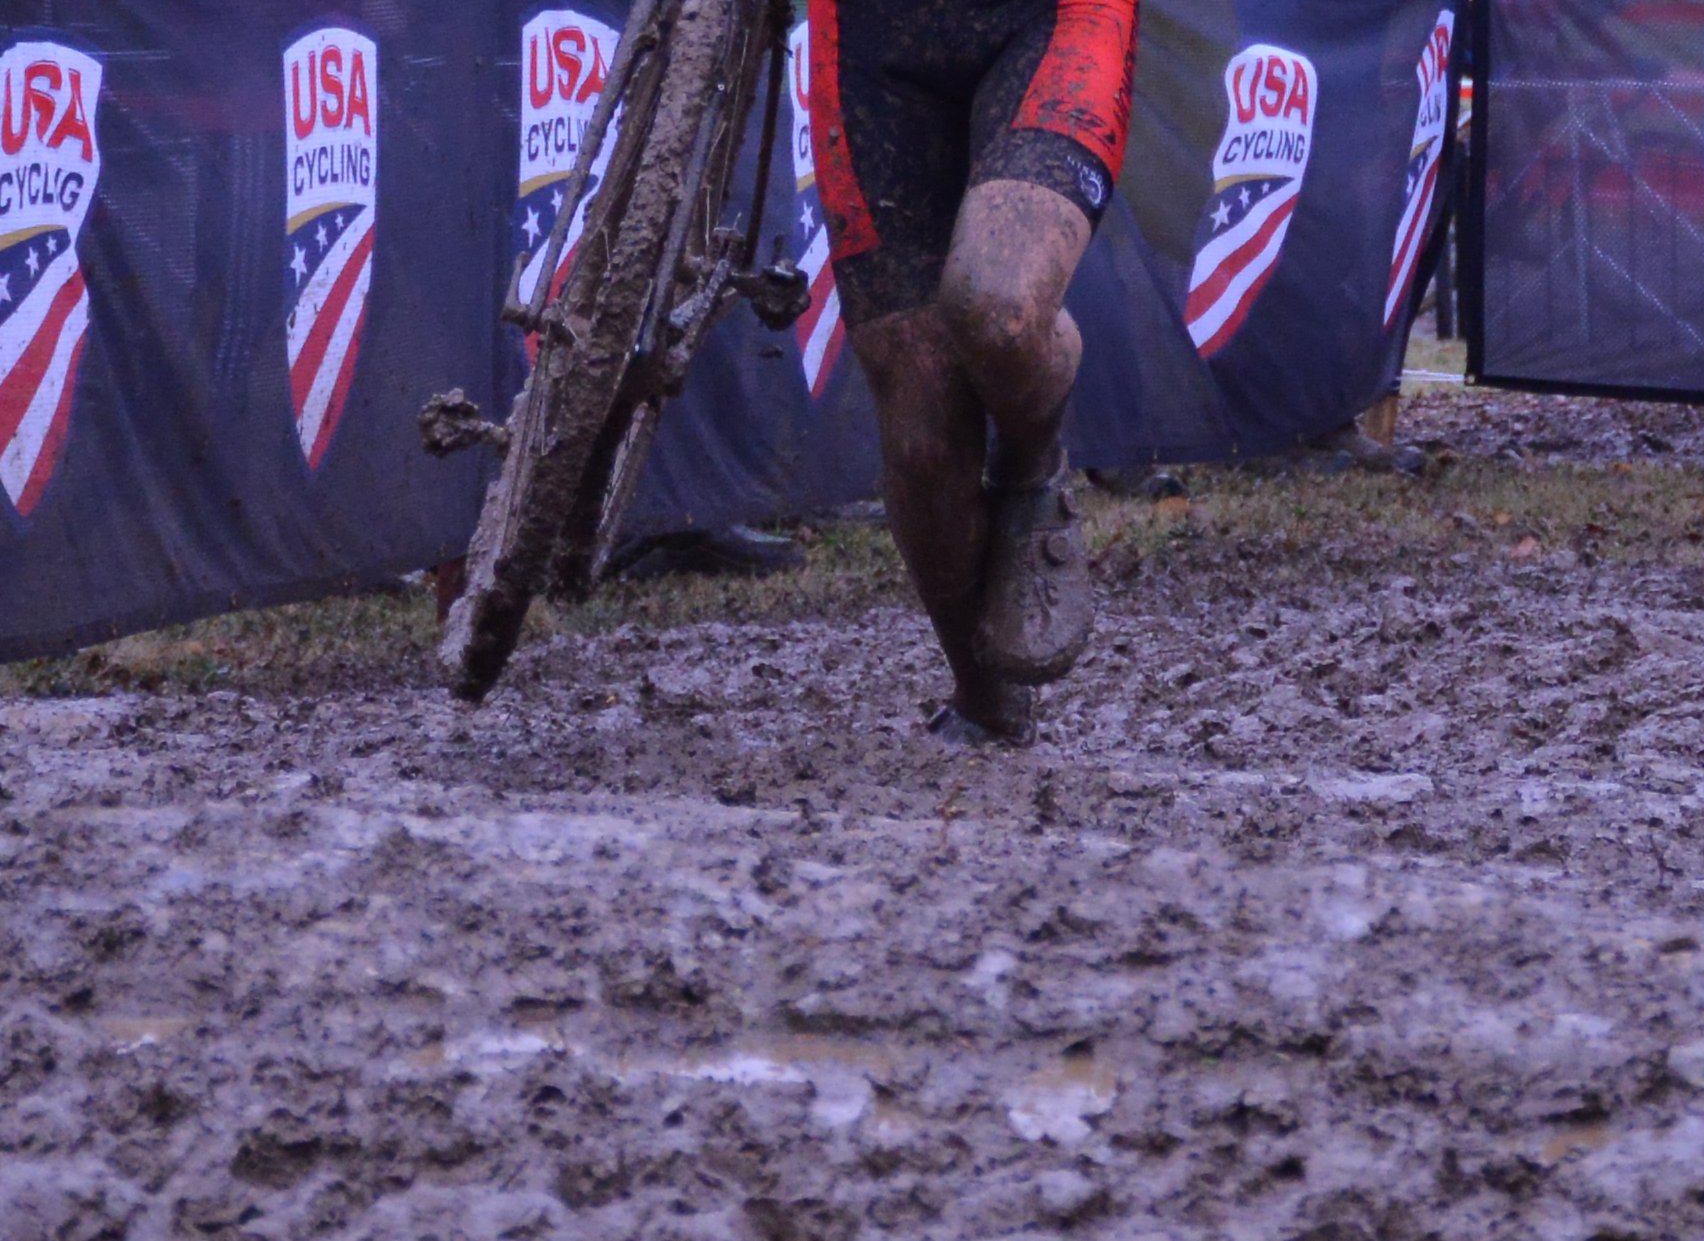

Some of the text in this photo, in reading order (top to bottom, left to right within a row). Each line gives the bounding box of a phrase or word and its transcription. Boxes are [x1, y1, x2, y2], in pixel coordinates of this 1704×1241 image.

[292, 45, 371, 140] USA
[530, 26, 609, 109] USA
[1233, 54, 1308, 127] USA
[2, 59, 93, 163] USA
[528, 116, 589, 162] CYCL
[294, 144, 370, 196] CYCLING
[1222, 130, 1306, 165] CYCLING
[0, 162, 84, 215] CYCLIG
